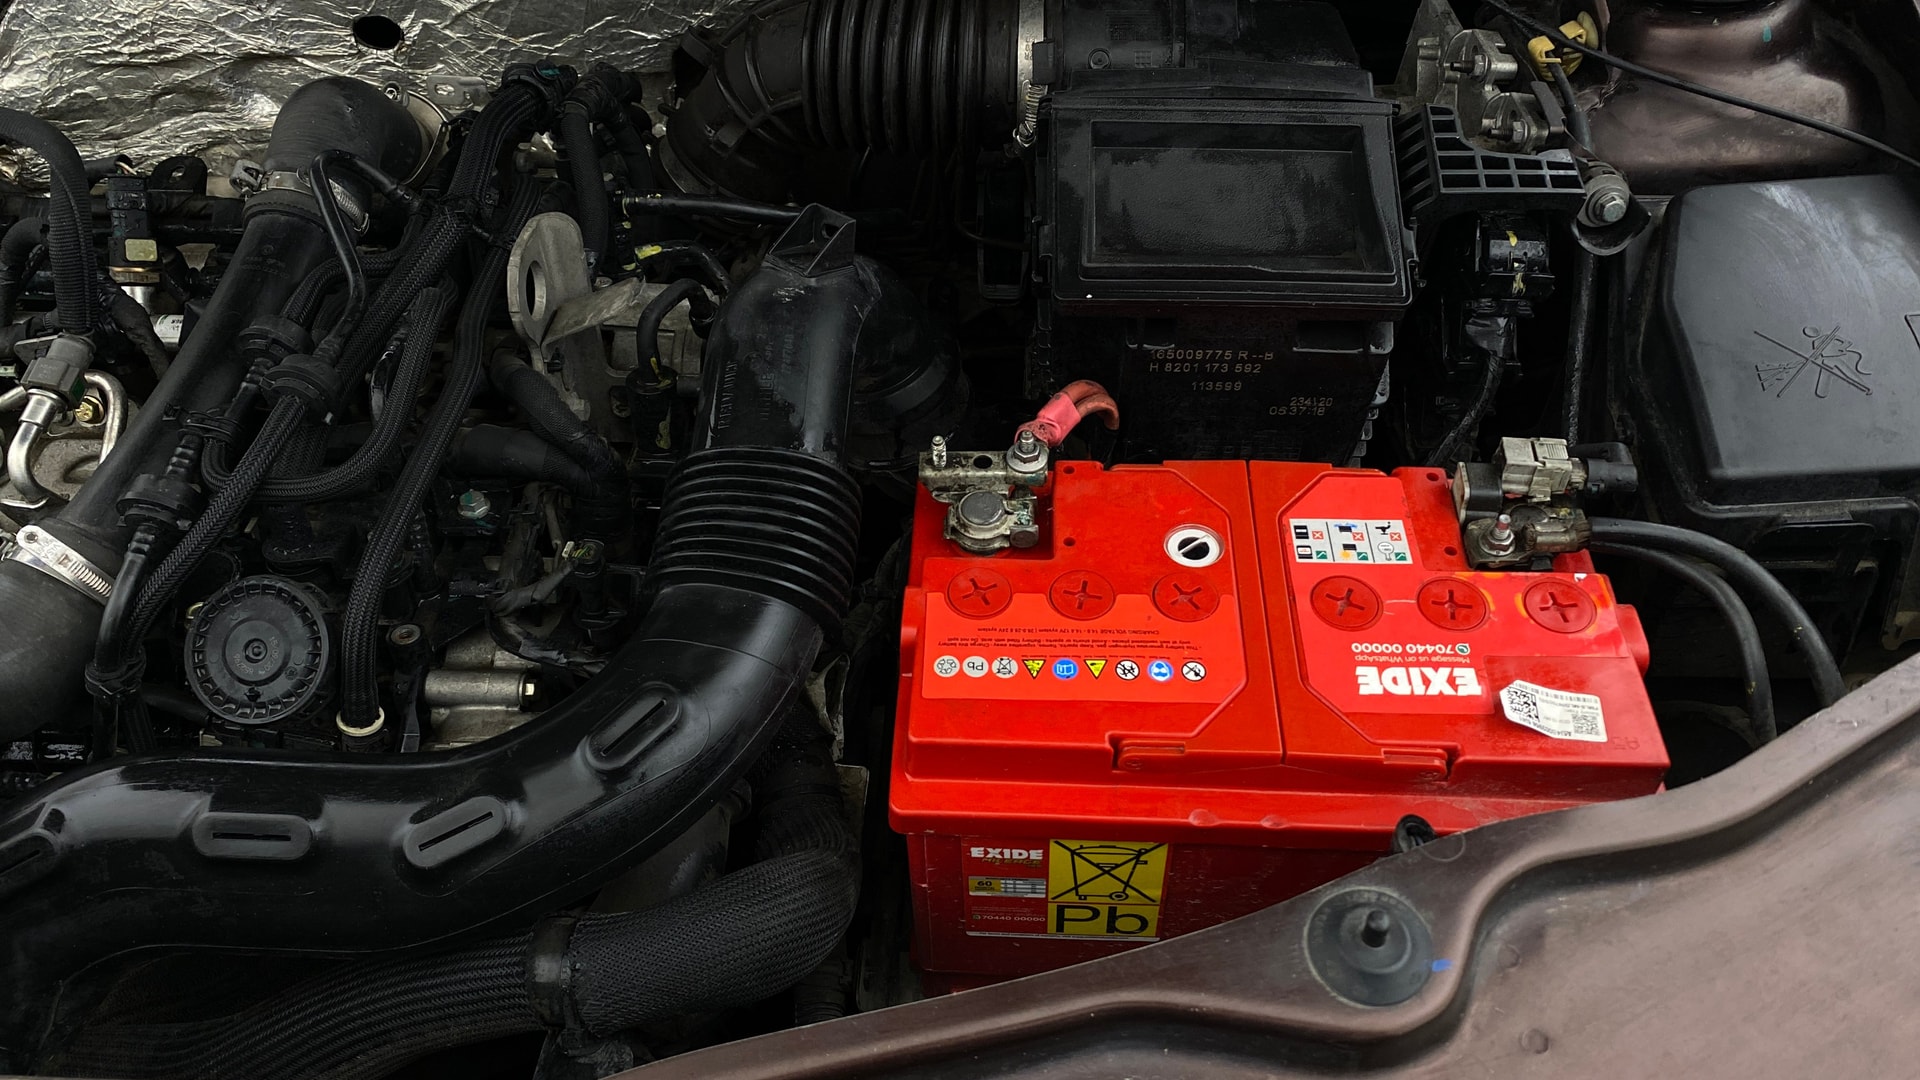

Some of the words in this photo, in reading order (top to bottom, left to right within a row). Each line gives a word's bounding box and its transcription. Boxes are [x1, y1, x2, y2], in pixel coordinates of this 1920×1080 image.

[1149, 362, 1159, 373] H
[1164, 362, 1199, 373] 8201
[1205, 363, 1229, 374] 173
[1234, 363, 1262, 374] 592
[1191, 381, 1243, 391] 113599
[1351, 642, 1403, 653] 00000
[1405, 643, 1454, 654] 70440
[1355, 654, 1404, 663] WhatsApp
[1431, 654, 1470, 663] Message
[966, 660, 985, 671] Pb
[1355, 666, 1482, 696] EXIDE
[970, 847, 1044, 860] EXIDE
[1055, 904, 1149, 935] Pb
